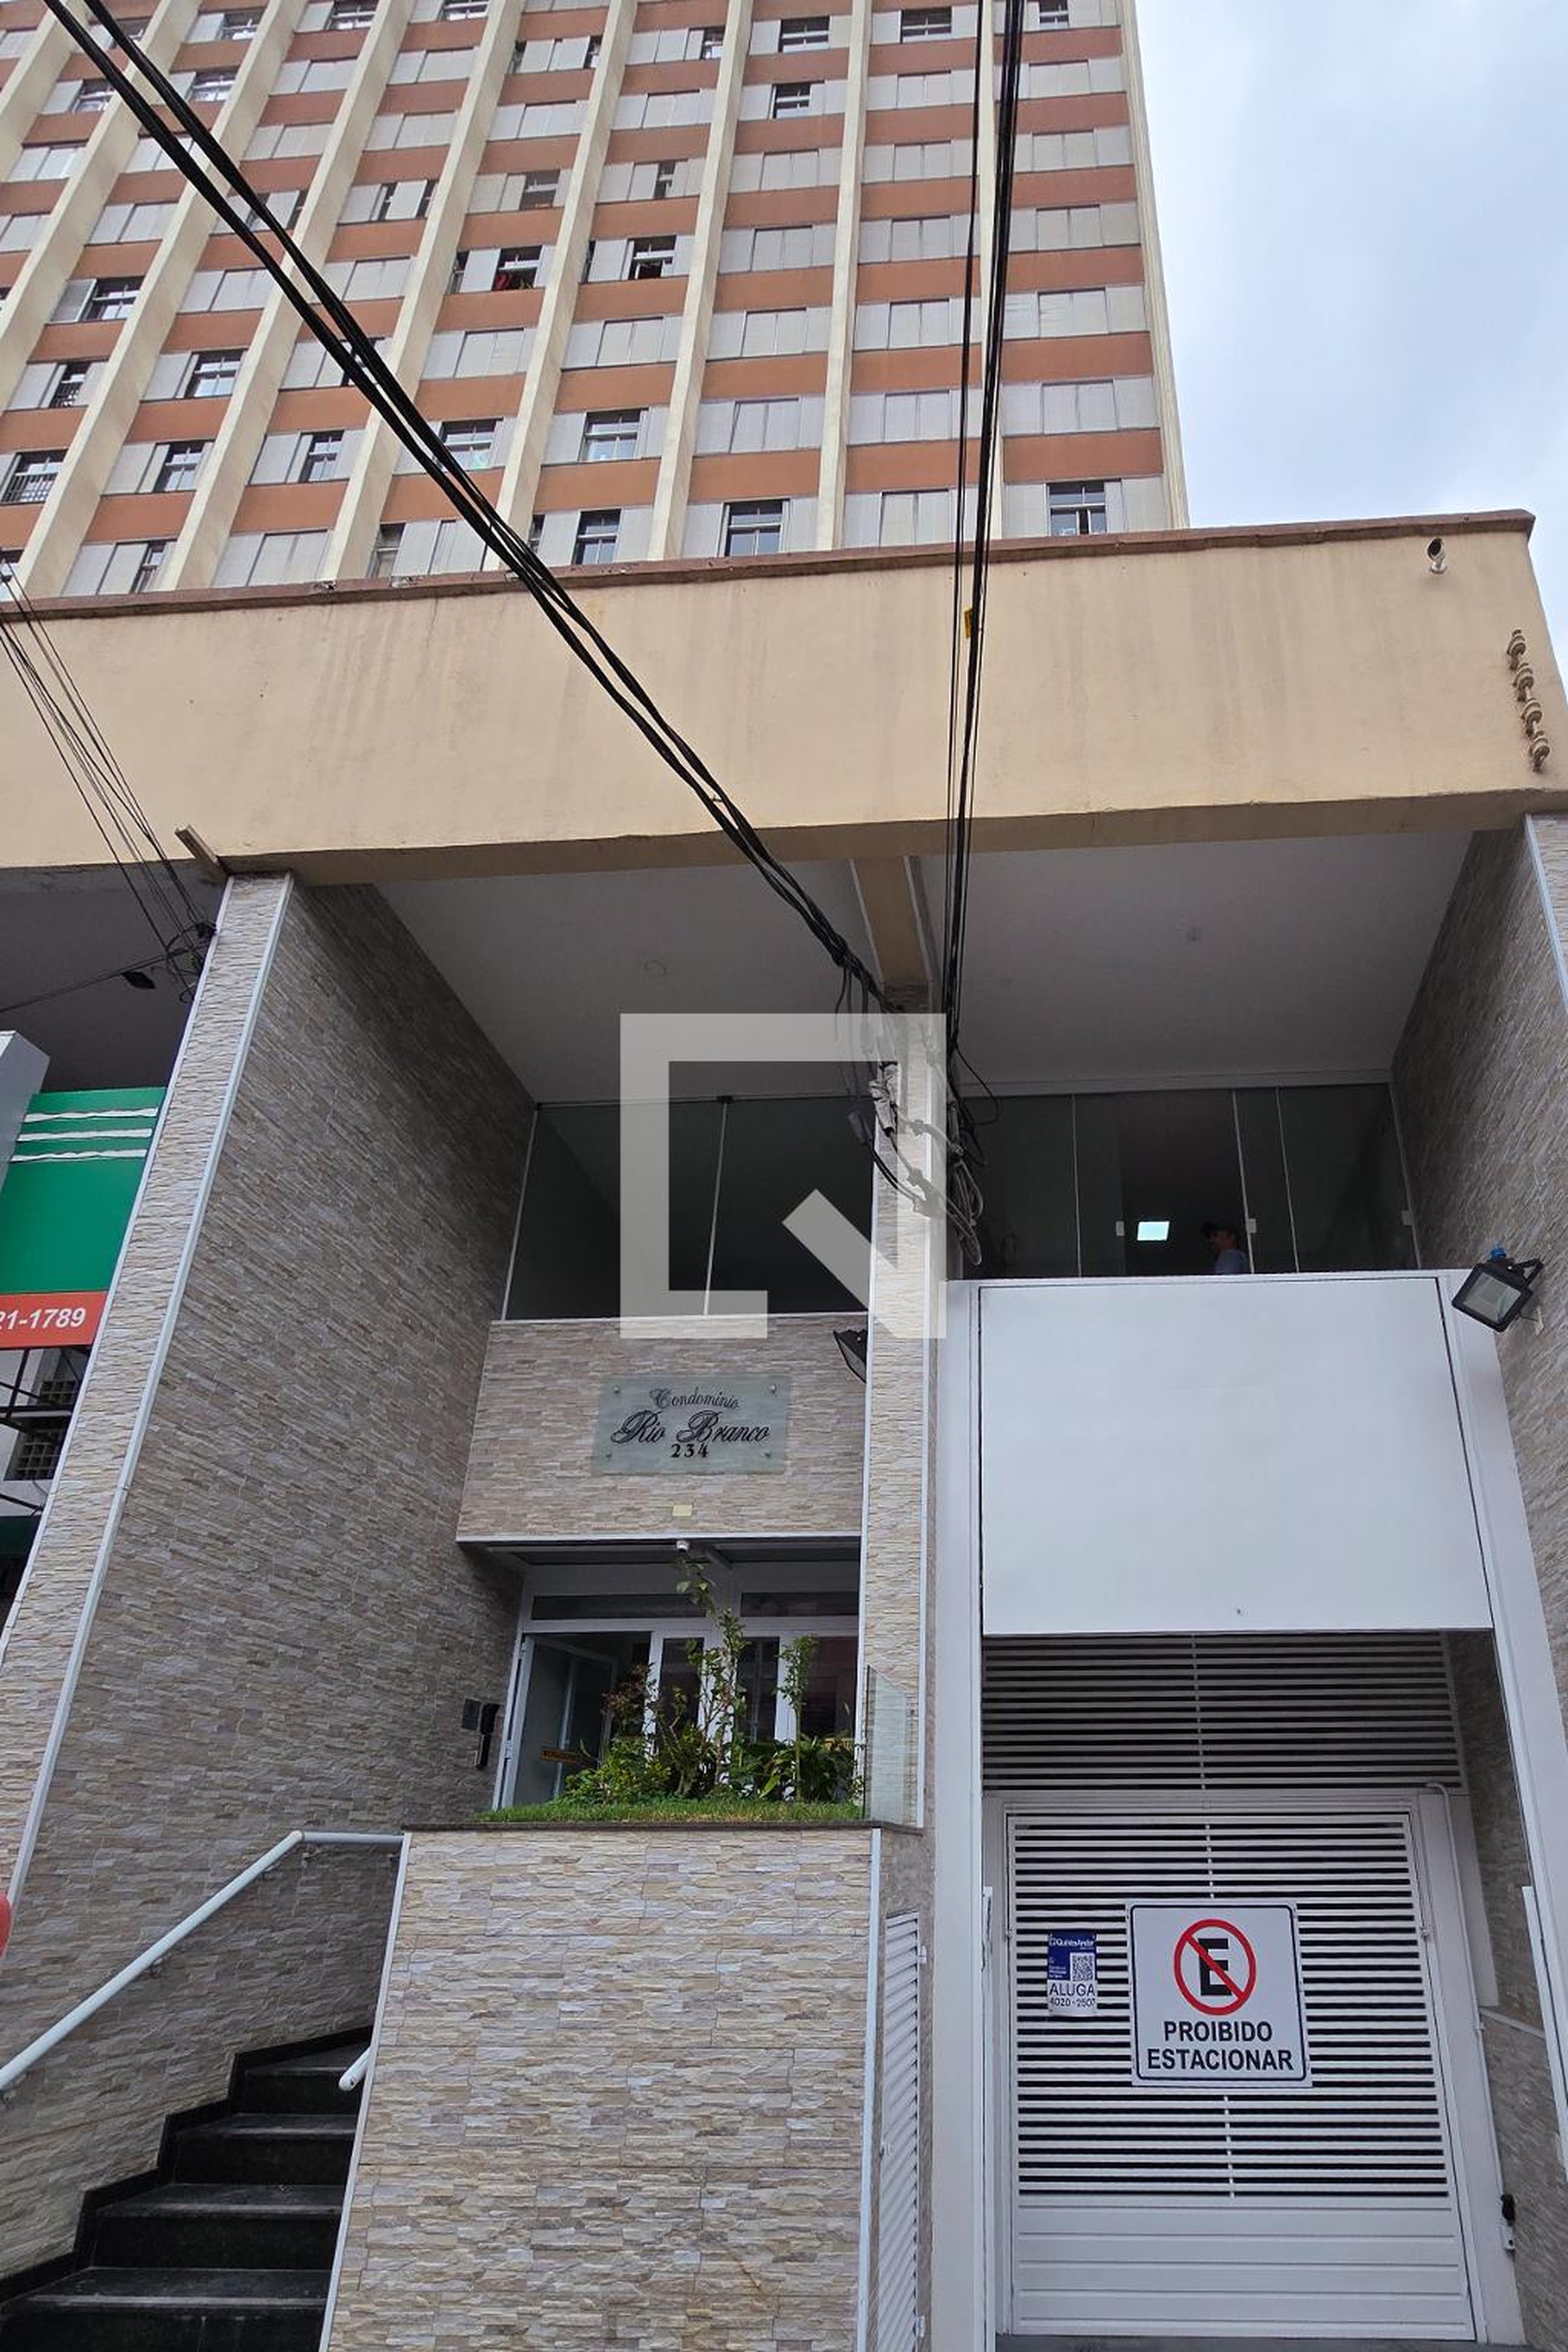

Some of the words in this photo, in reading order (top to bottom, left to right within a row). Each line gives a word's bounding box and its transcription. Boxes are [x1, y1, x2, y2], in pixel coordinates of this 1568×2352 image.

[611, 1410, 666, 1443] Rio
[676, 1410, 770, 1443] Branco
[671, 1443, 709, 1458] 234
[1198, 1938, 1232, 1996] E
[1049, 1983, 1095, 1996] ALUGA
[1164, 2021, 1273, 2042] PROIBIDO
[1147, 2049, 1294, 2070] ESTACIONAR
